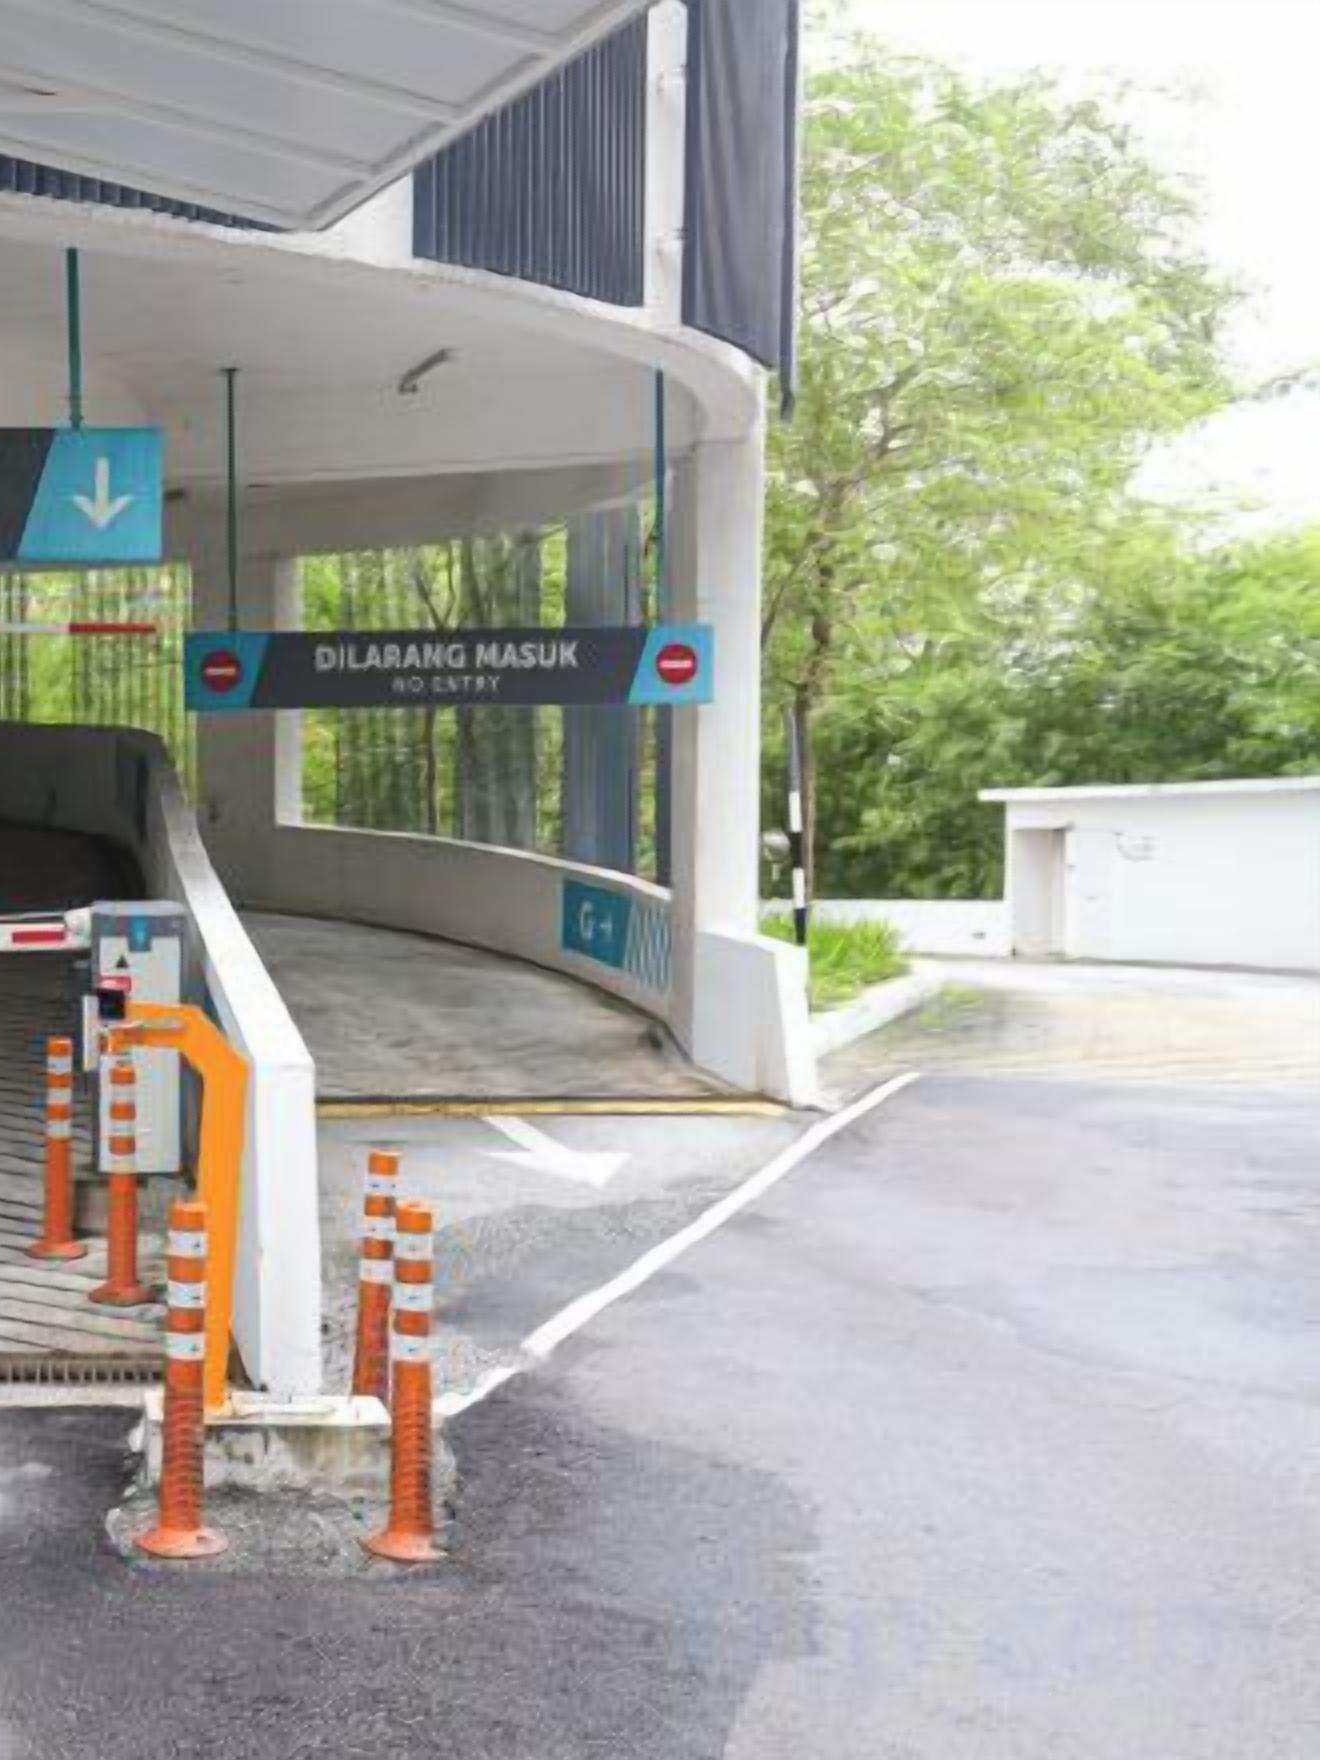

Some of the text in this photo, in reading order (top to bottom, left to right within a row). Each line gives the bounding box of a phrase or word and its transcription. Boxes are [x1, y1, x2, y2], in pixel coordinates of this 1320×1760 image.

[315, 640, 579, 671] DILARANG MASUK
[392, 676, 501, 693] NO ENTRY
